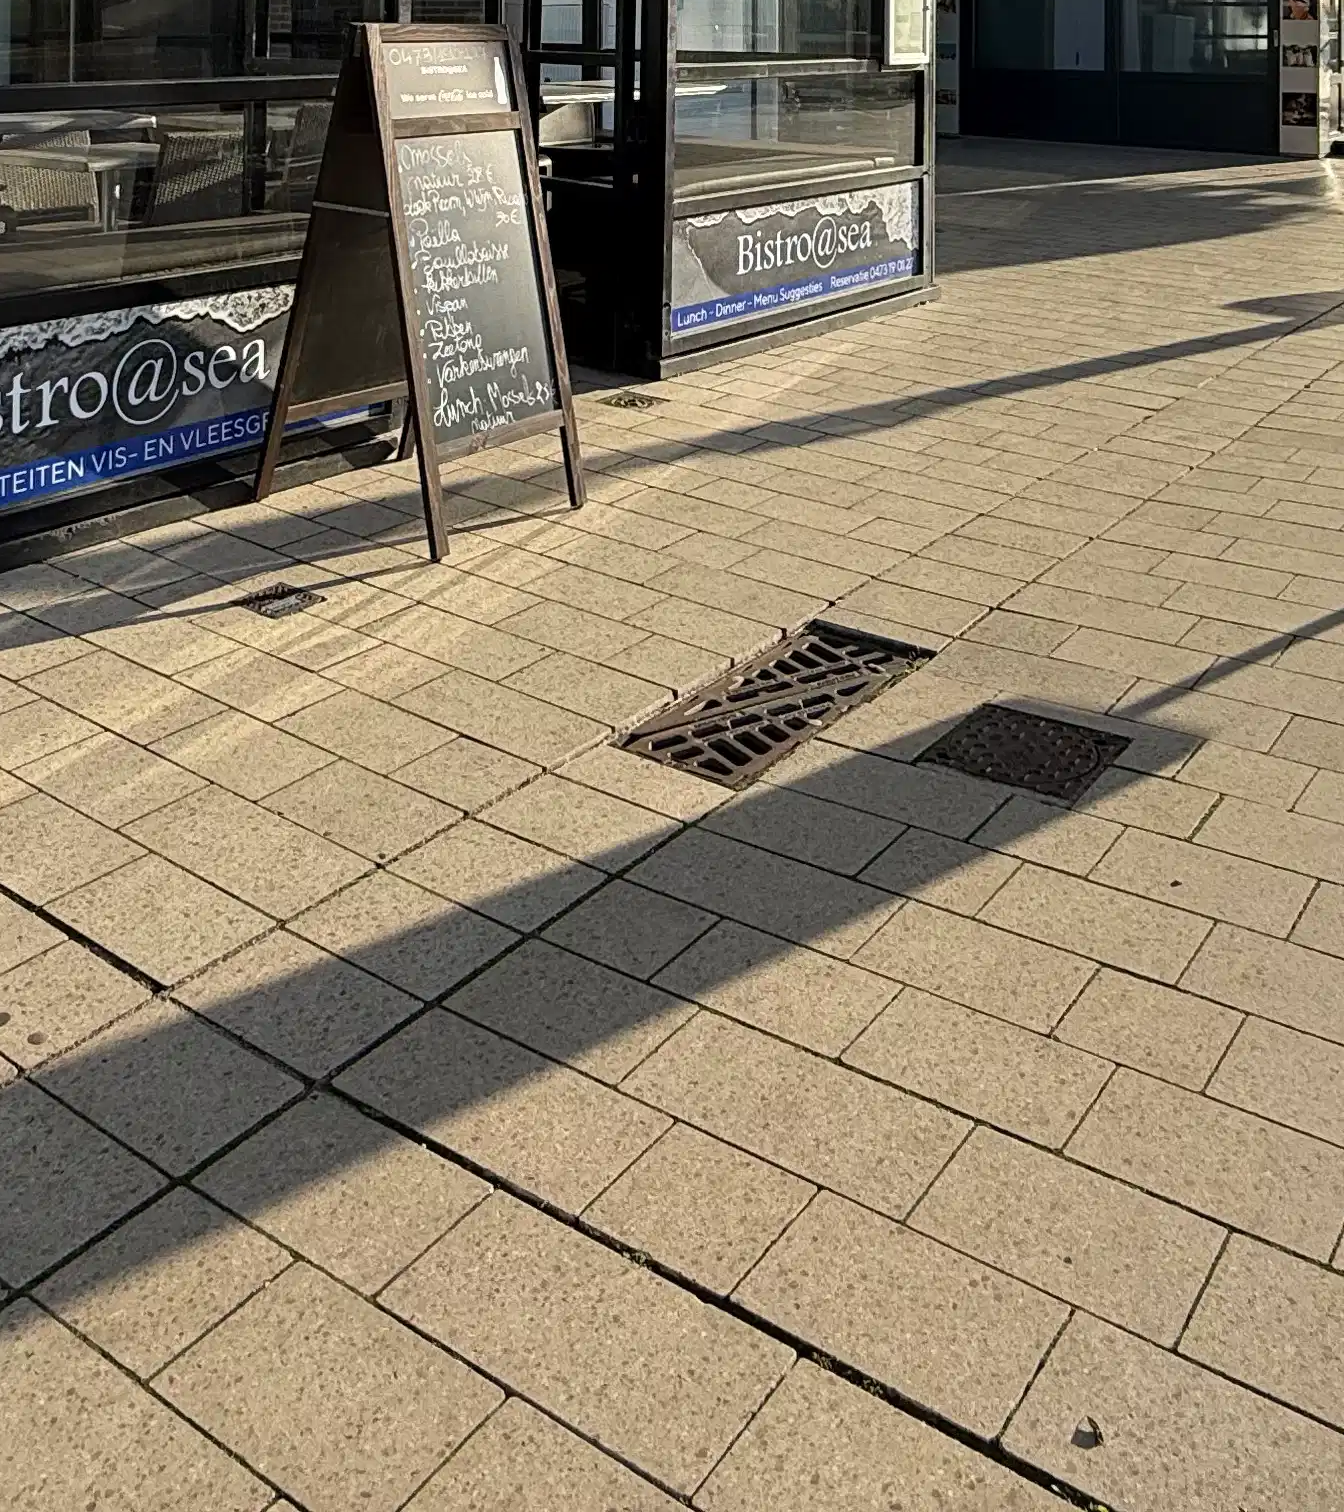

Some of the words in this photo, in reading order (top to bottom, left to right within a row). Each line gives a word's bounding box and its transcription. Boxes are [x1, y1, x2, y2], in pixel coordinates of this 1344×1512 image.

[736, 216, 872, 276] Bistro@sea
[677, 308, 707, 327] Lunch
[716, 300, 746, 318] Dinner
[754, 293, 778, 309] Menu
[779, 281, 823, 302] Suggesties
[830, 270, 869, 289] Reservatie
[91, 446, 138, 473] VIS-
[144, 435, 175, 461] EN
